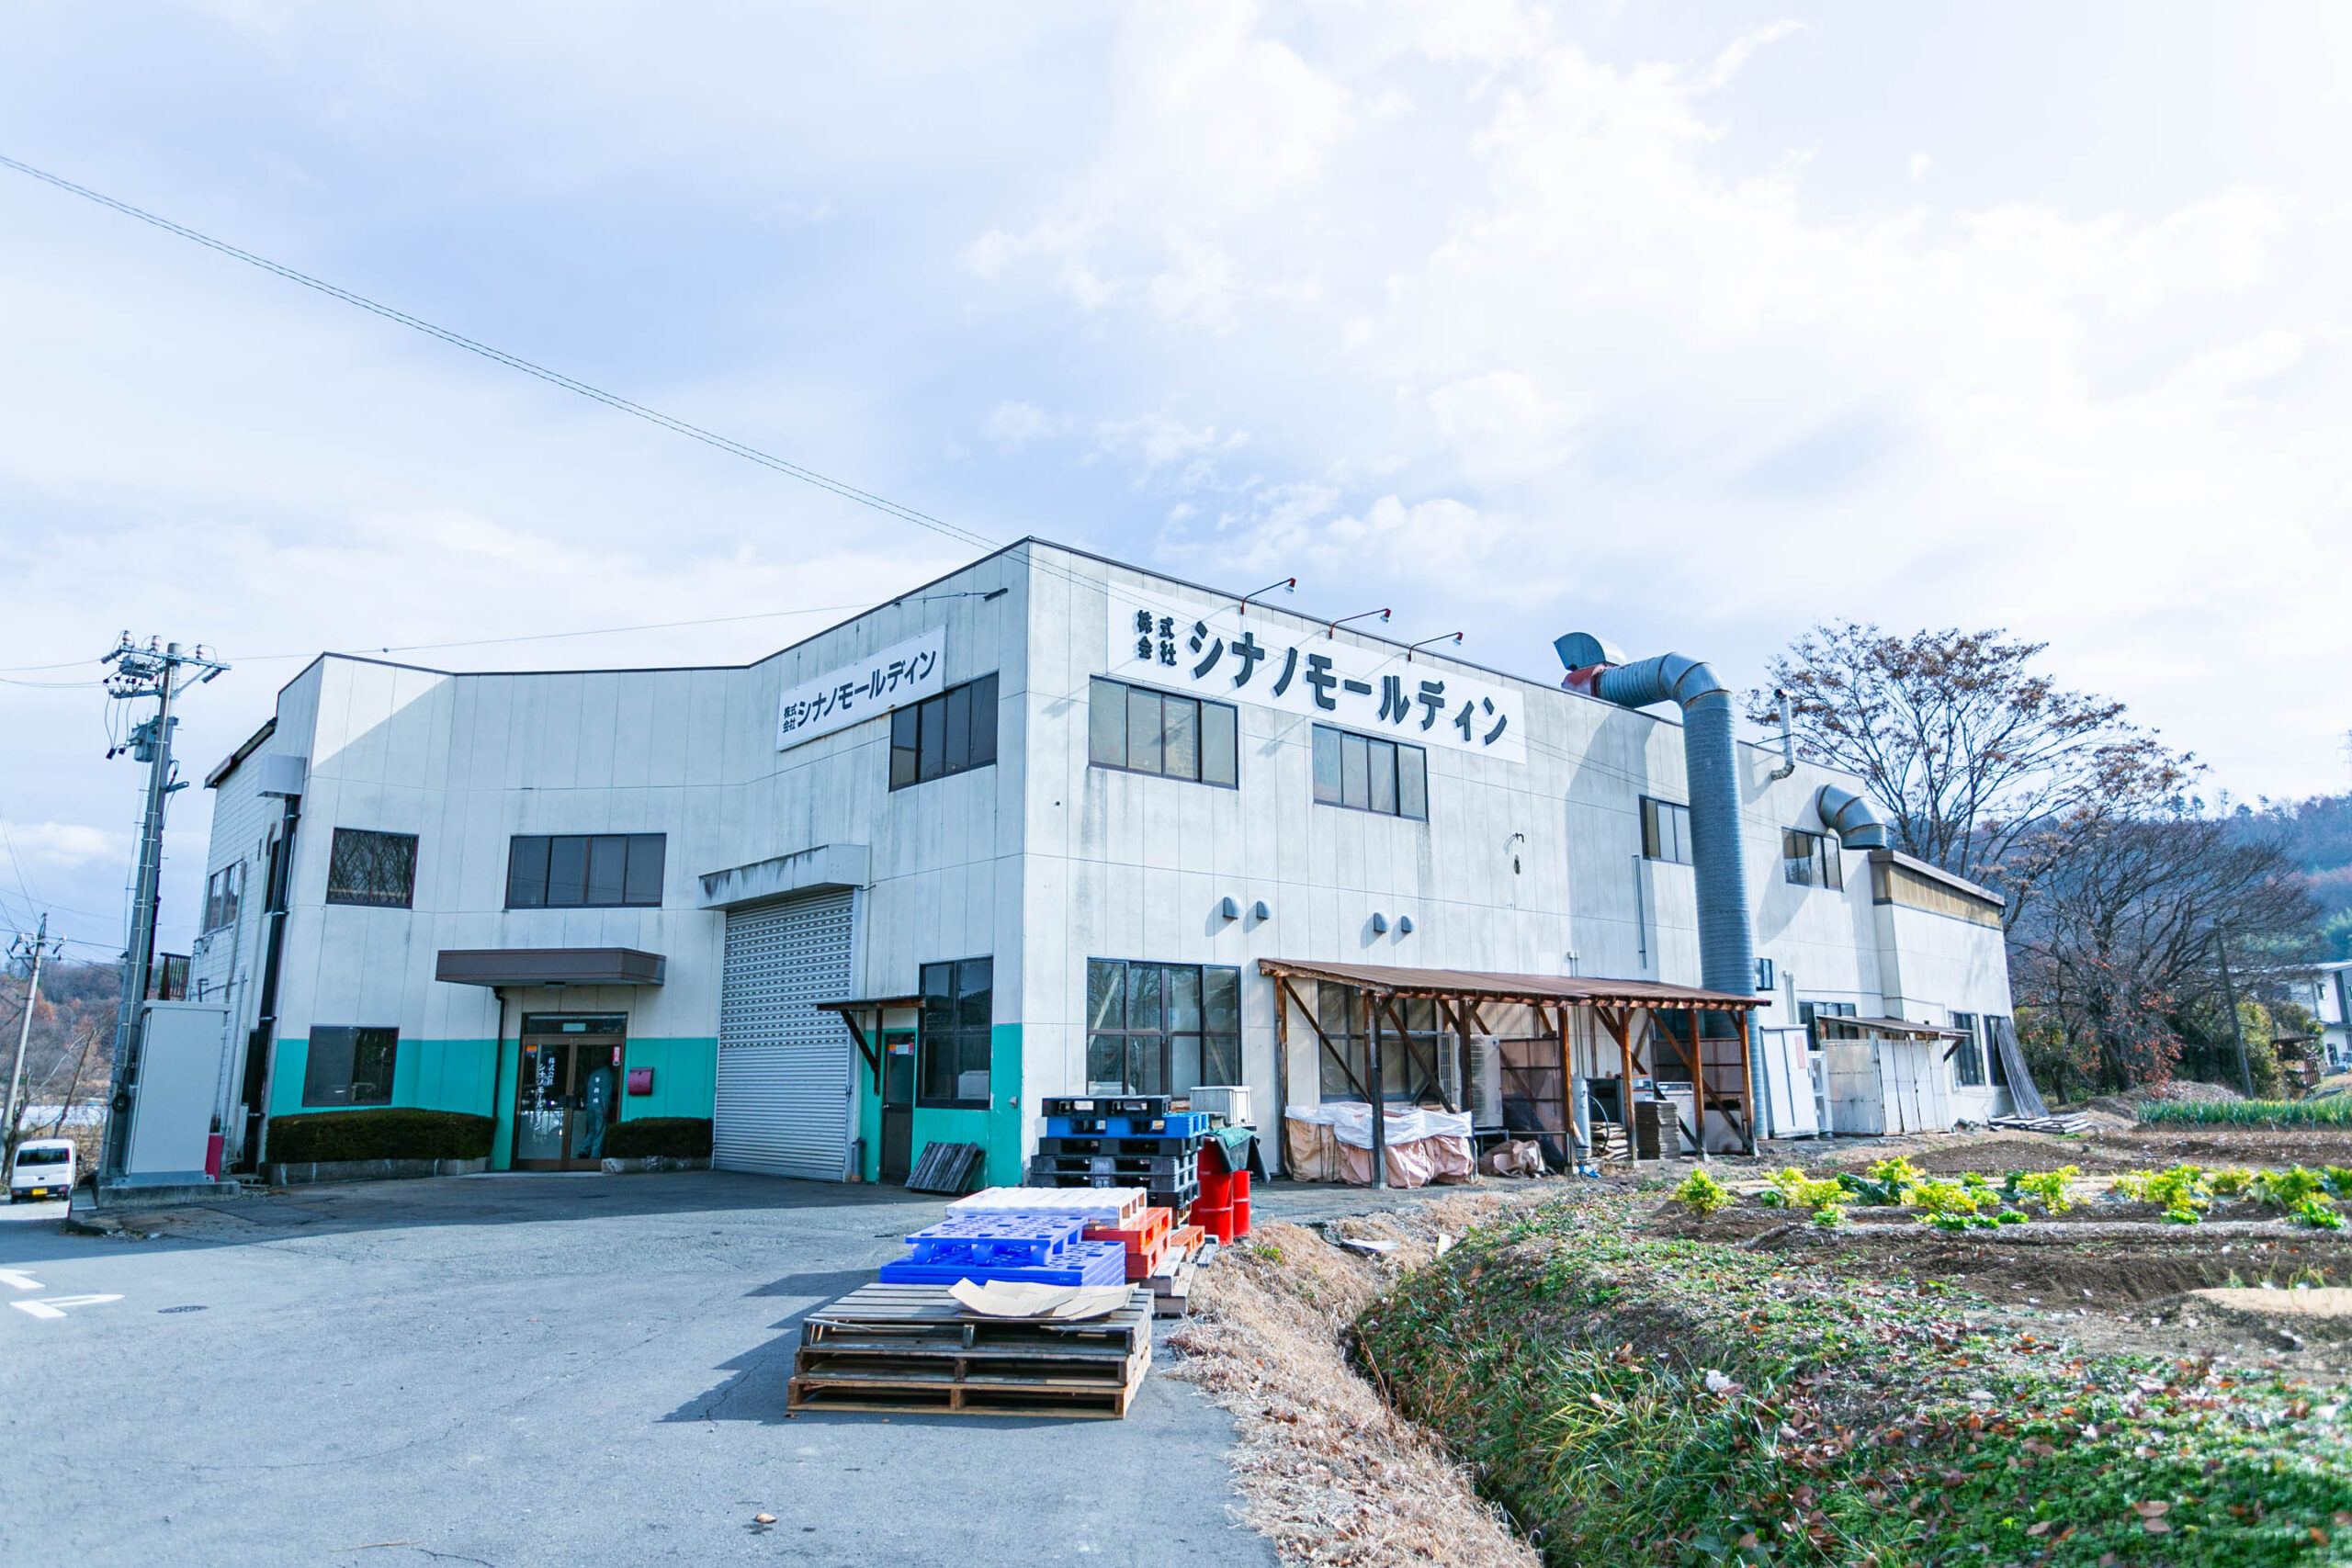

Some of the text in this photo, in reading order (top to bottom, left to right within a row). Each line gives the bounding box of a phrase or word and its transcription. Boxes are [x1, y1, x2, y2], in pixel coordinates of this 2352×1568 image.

[1136, 609, 1175, 640] 株式
[1137, 635, 1178, 667] 会社
[797, 650, 937, 728] シナノモールディン
[1189, 620, 1508, 745] シナノモールディン
[782, 717, 797, 734] 会社
[783, 702, 797, 718] 株式
